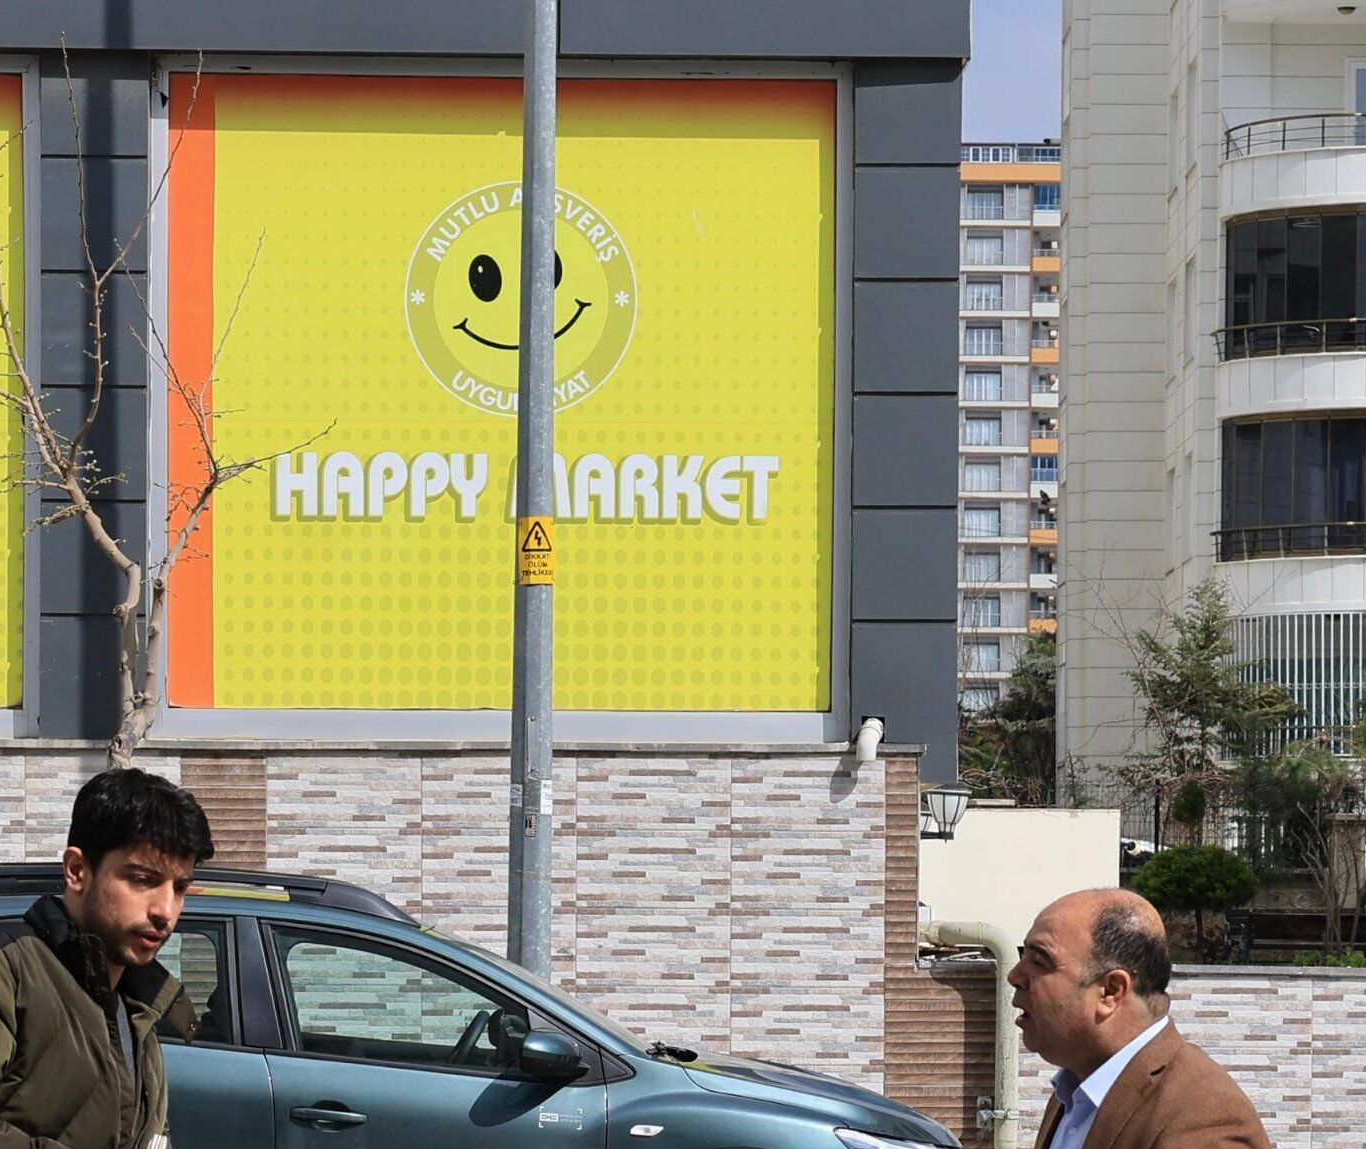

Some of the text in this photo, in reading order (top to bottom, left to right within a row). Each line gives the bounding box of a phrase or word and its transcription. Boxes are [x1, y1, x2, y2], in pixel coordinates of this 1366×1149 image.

[426, 191, 500, 262] MUTLU
[451, 369, 591, 412] UYGU YAT
[271, 450, 488, 523] HAPPY
